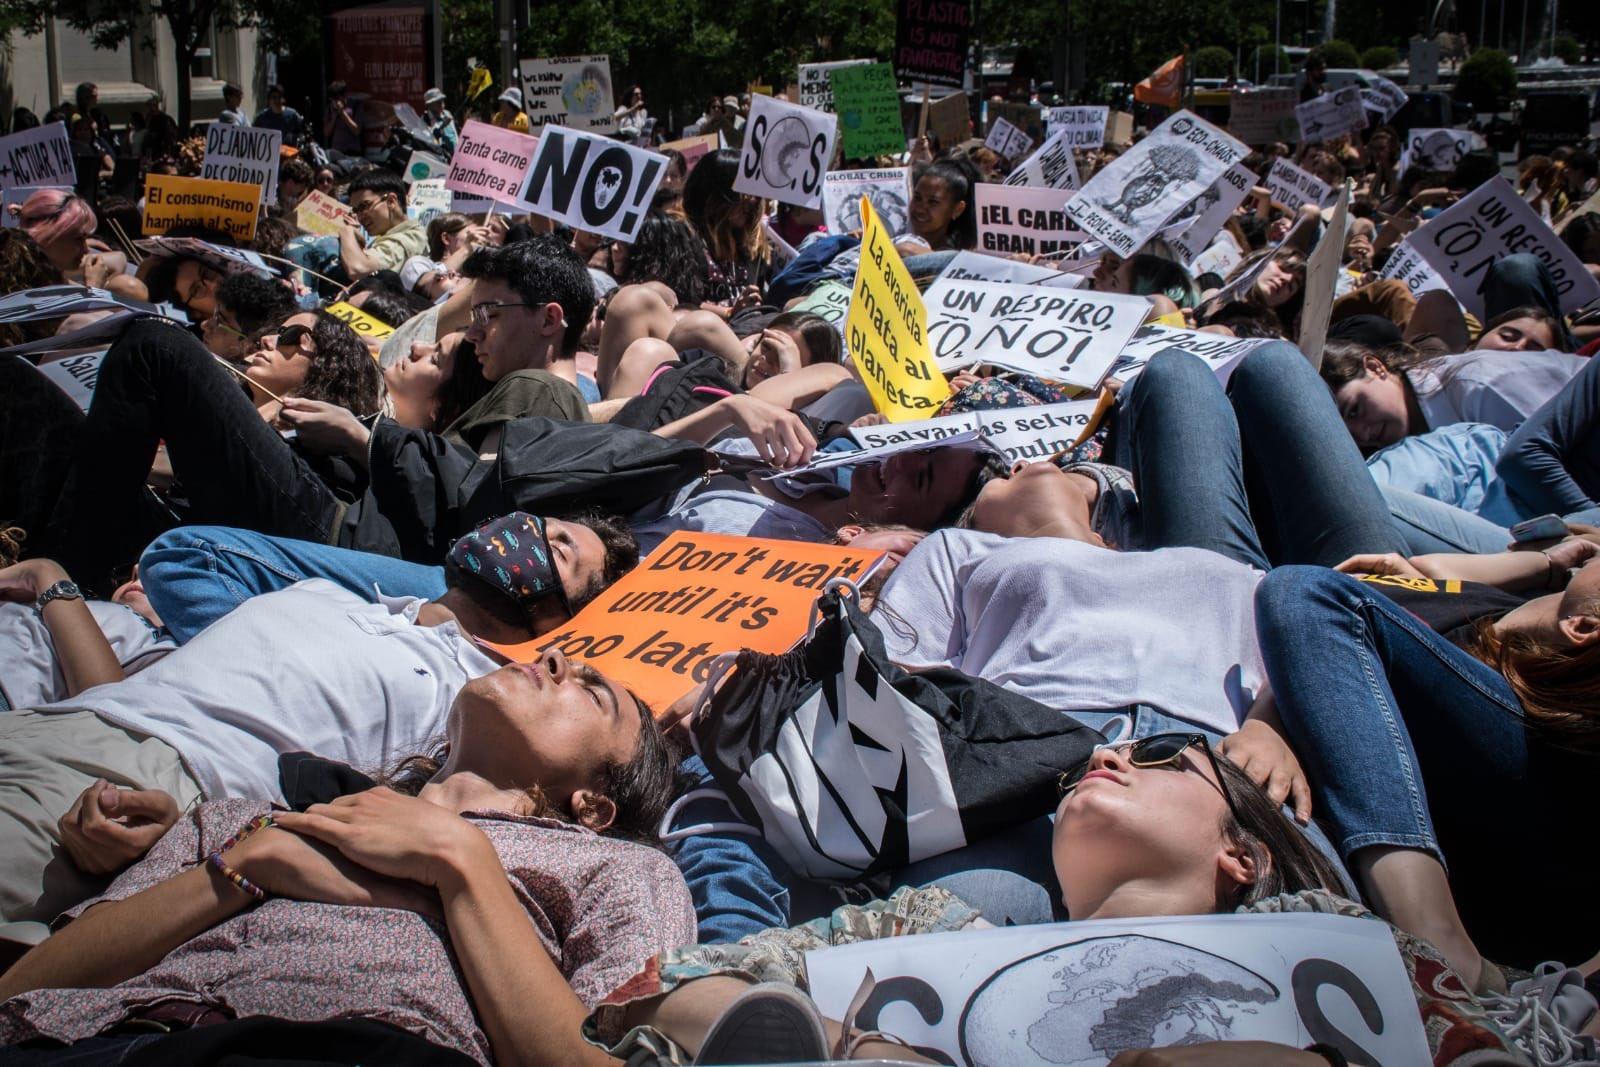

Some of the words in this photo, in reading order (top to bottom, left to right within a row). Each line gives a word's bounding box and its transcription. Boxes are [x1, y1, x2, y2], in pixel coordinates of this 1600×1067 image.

[929, 31, 959, 48] NOT
[806, 69, 819, 80] NO
[900, 48, 963, 73] FANTASTIC
[538, 71, 564, 82] KNOW
[528, 99, 547, 109] WE
[531, 86, 562, 96] WHAT
[530, 112, 568, 126] WANT
[207, 125, 275, 162] DEJADNOS
[458, 135, 492, 159] Tanta
[492, 148, 528, 171] carne
[449, 161, 507, 192] hambrea
[507, 181, 525, 198] al
[524, 130, 662, 236] NO!
[825, 172, 867, 182] GLOBAL
[868, 171, 905, 180] CRISIS
[148, 186, 163, 205] El
[166, 193, 255, 214] consumismo
[1478, 196, 1513, 229] UN
[224, 216, 252, 236] Sur!
[982, 231, 1036, 257] GRAN
[868, 226, 884, 271] La
[884, 261, 923, 347] avaricia
[943, 288, 987, 314] UN
[990, 295, 1116, 331] RESPIRO,
[859, 278, 899, 363] mata
[904, 356, 932, 381] al
[851, 324, 944, 409] planeta.
[648, 540, 767, 576] Don't
[764, 557, 866, 592] wait
[607, 585, 712, 621] until
[701, 591, 779, 630] it's
[534, 630, 625, 658] too
